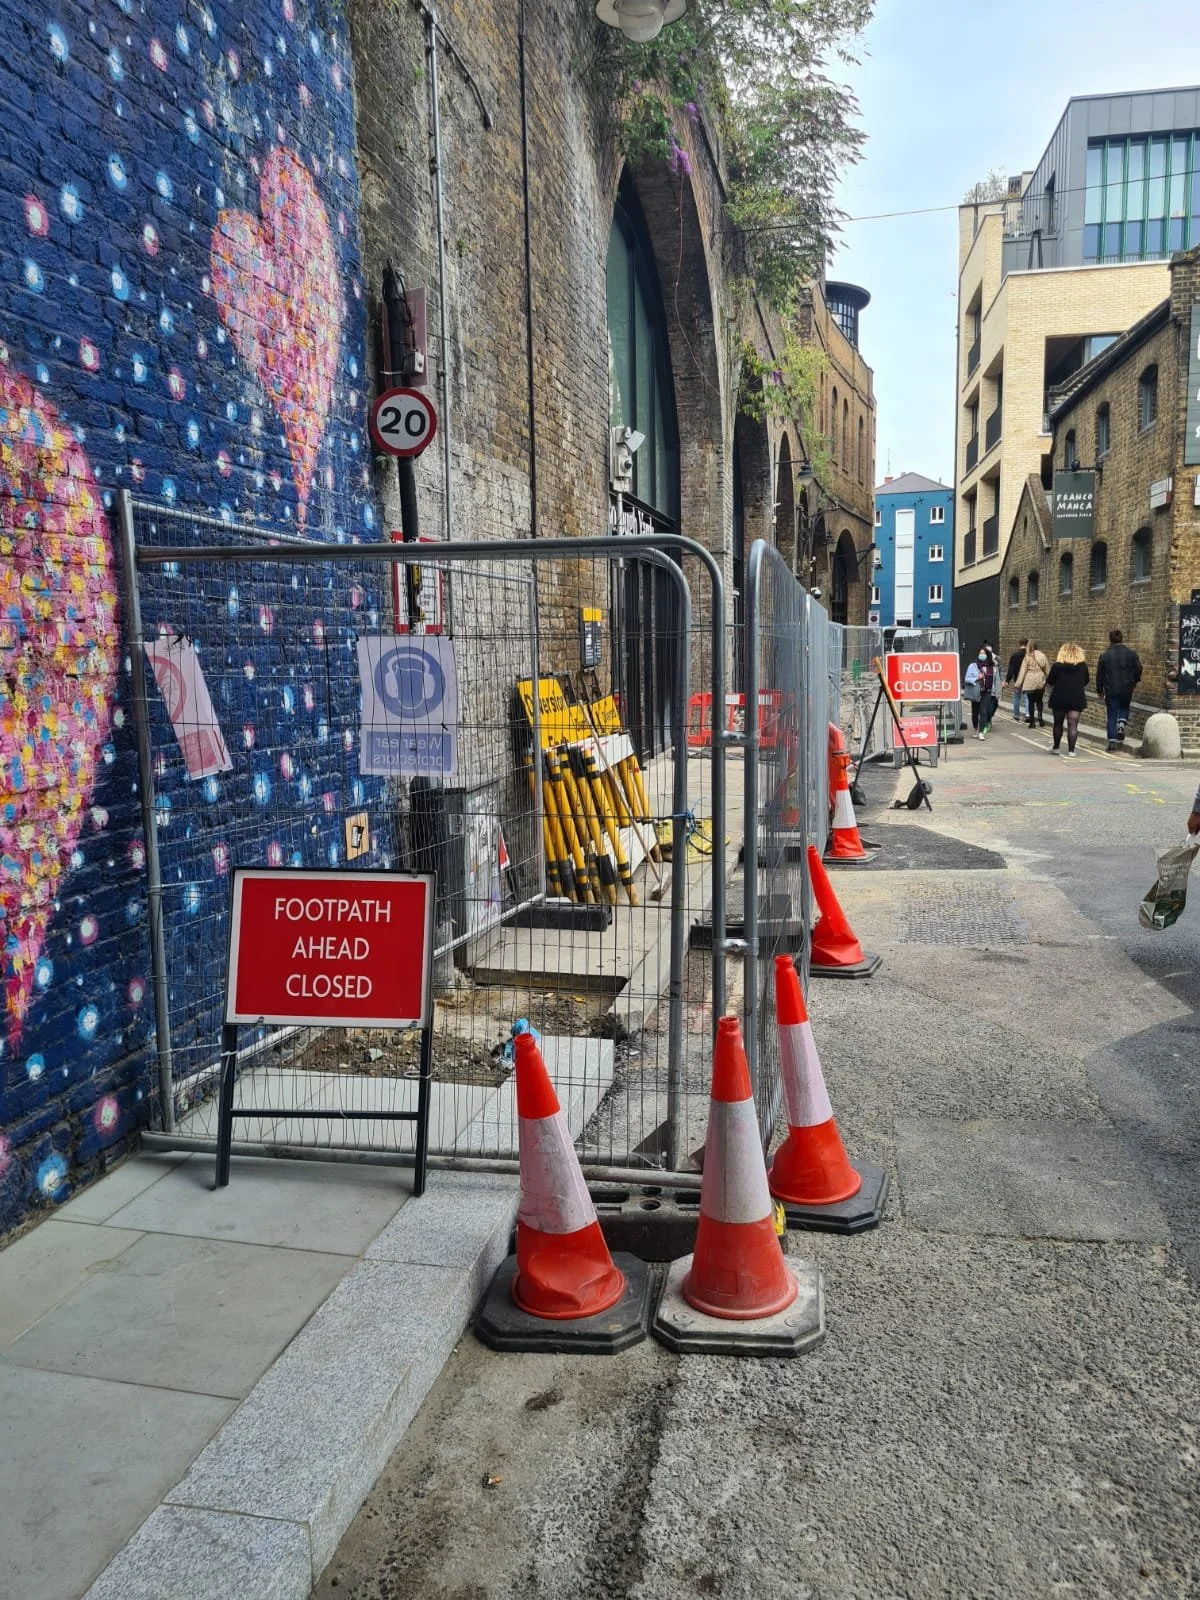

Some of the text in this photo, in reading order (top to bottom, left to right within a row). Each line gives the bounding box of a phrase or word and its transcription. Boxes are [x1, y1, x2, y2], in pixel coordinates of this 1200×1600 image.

[381, 406, 426, 437] 20
[1056, 493, 1093, 502] FRANCO
[1056, 502, 1093, 511] MANCA
[902, 662, 943, 674] ROAD
[894, 680, 952, 692] CLOSED
[274, 897, 391, 923] FOOTPATH
[291, 936, 370, 960] AHEAD
[286, 974, 373, 998] CLOSED
